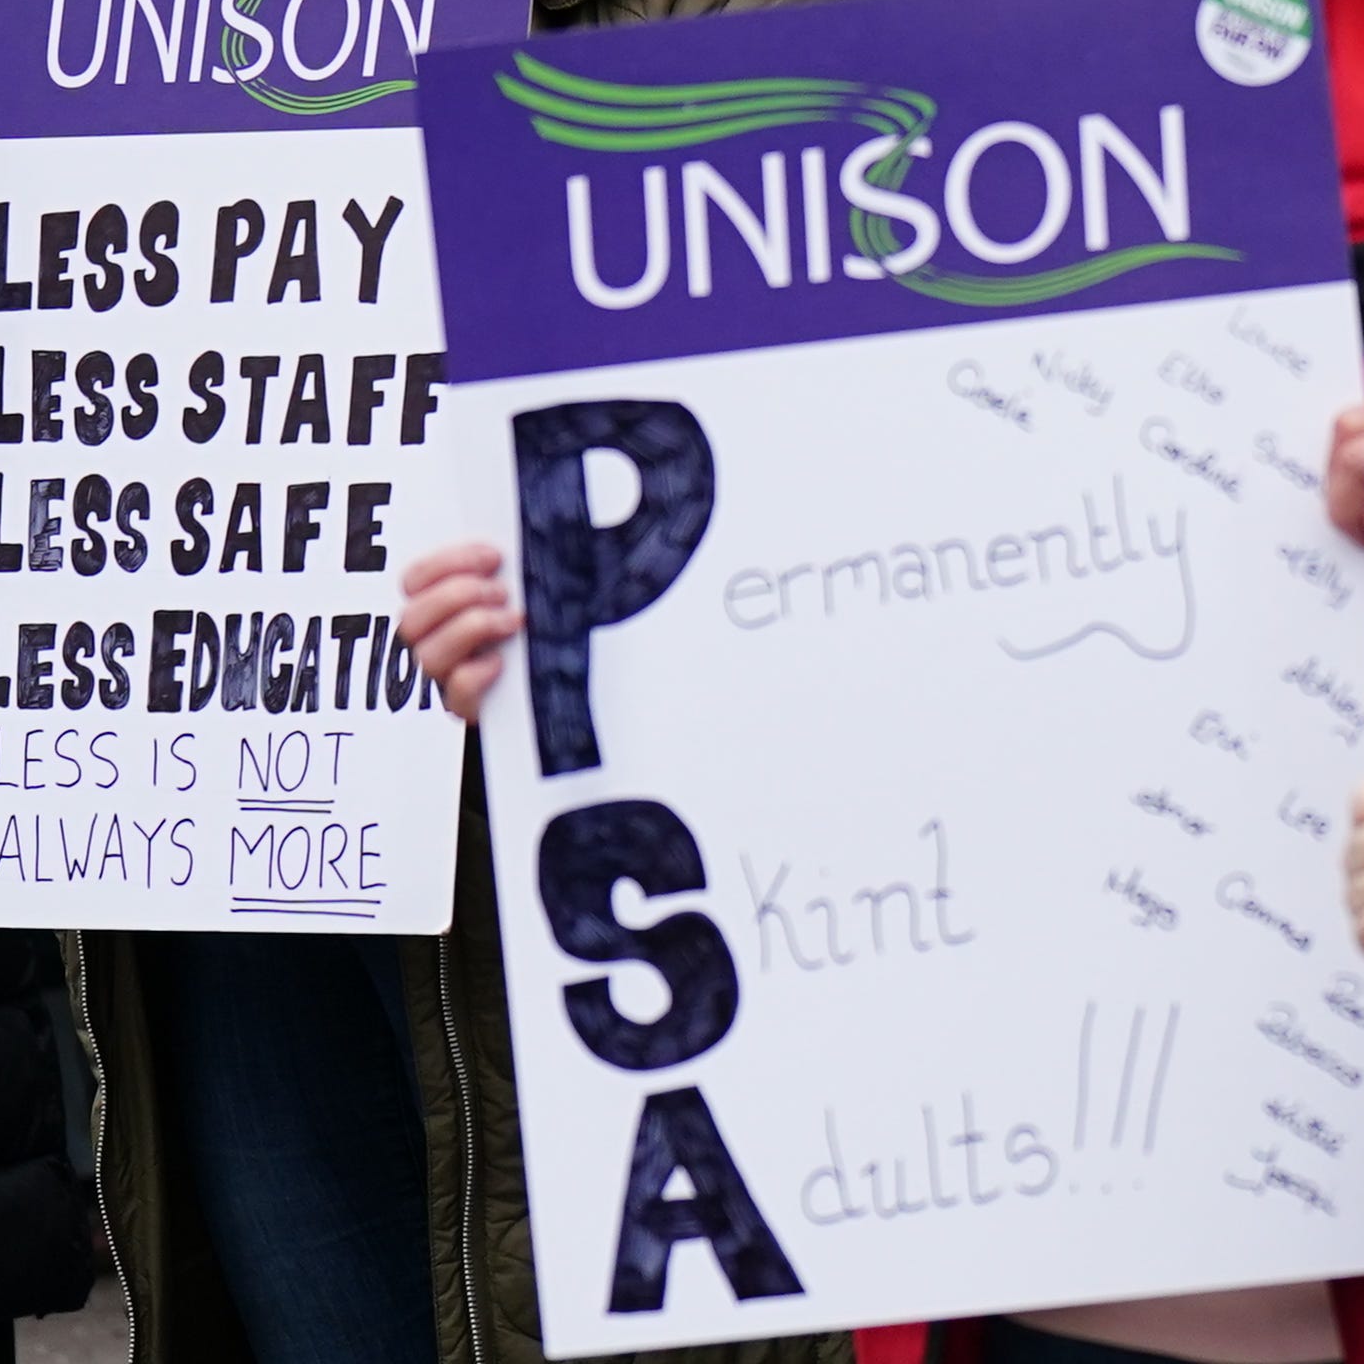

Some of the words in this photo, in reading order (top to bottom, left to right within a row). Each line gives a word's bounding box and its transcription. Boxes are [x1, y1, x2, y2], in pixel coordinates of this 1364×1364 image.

[209, 195, 405, 305] PAY
[565, 103, 1191, 311] UNISON
[182, 350, 449, 447] STAFF
[169, 477, 392, 576] SAFE
[152, 733, 198, 791] IS
[238, 730, 355, 793] NOT
[229, 822, 388, 891] MORE
